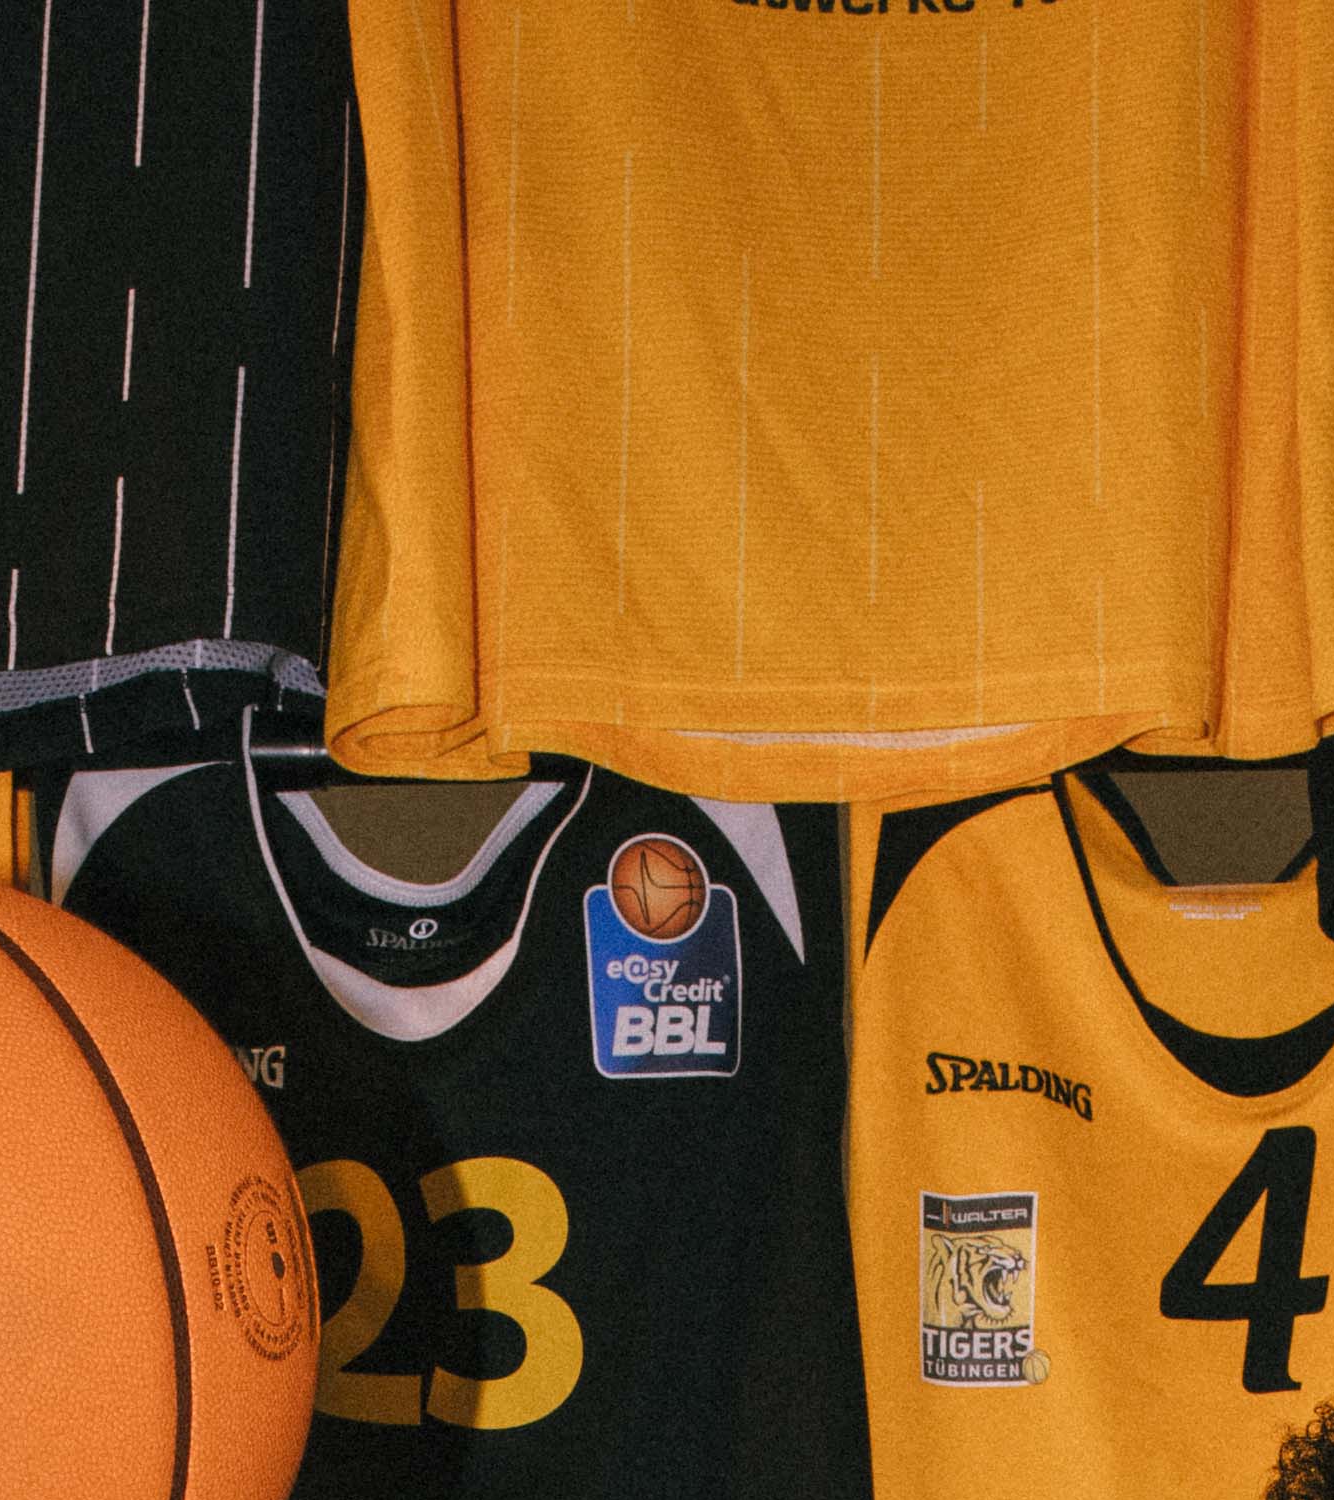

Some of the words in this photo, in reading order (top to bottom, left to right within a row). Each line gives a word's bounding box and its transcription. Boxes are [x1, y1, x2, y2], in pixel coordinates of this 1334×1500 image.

[612, 1005, 727, 1057] BBL
[925, 1051, 1094, 1122] SPALDING
[951, 1207, 1028, 1225] WALTER
[1159, 1124, 1331, 1394] 4
[299, 1156, 584, 1430] 23
[923, 1328, 1032, 1360] TIGERS
[925, 1358, 1020, 1378] TÜBINGEN
